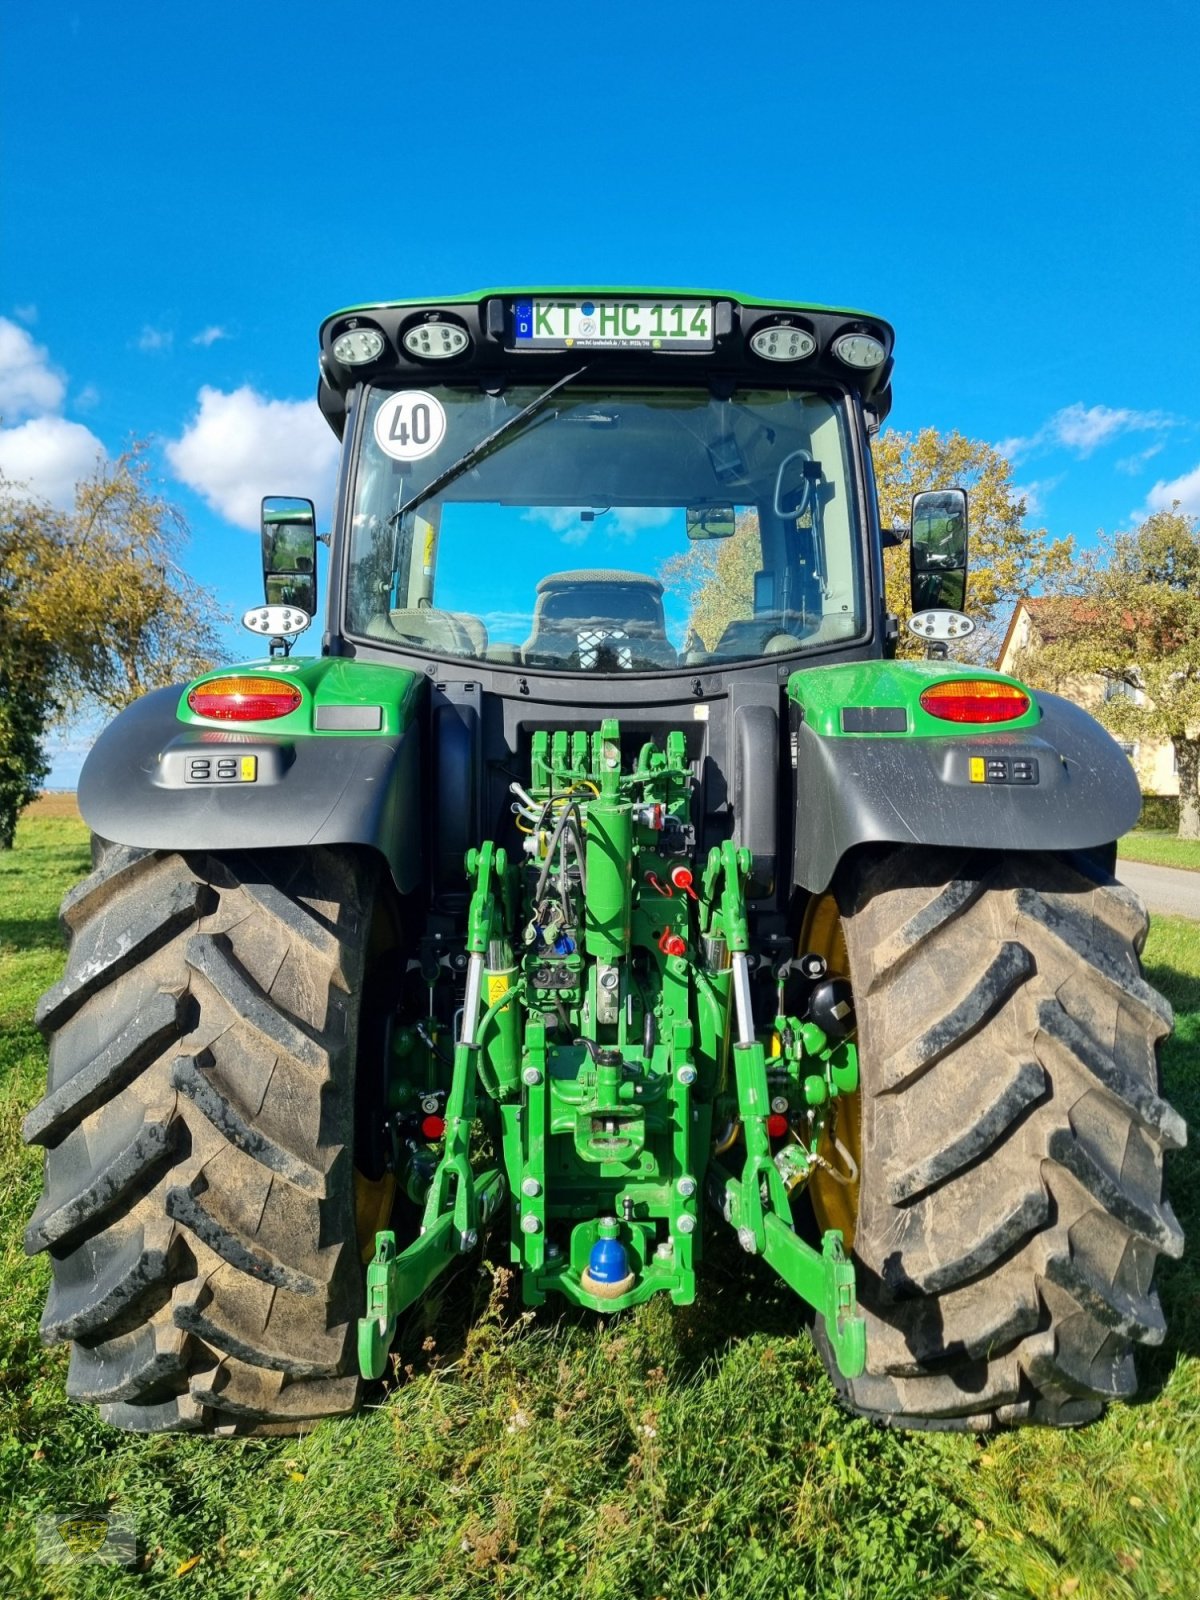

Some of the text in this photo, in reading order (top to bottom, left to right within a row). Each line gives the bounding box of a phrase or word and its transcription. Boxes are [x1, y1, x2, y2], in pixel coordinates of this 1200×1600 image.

[520, 322, 528, 333] D
[535, 303, 708, 337] KT HC 114
[388, 403, 431, 446] 40
